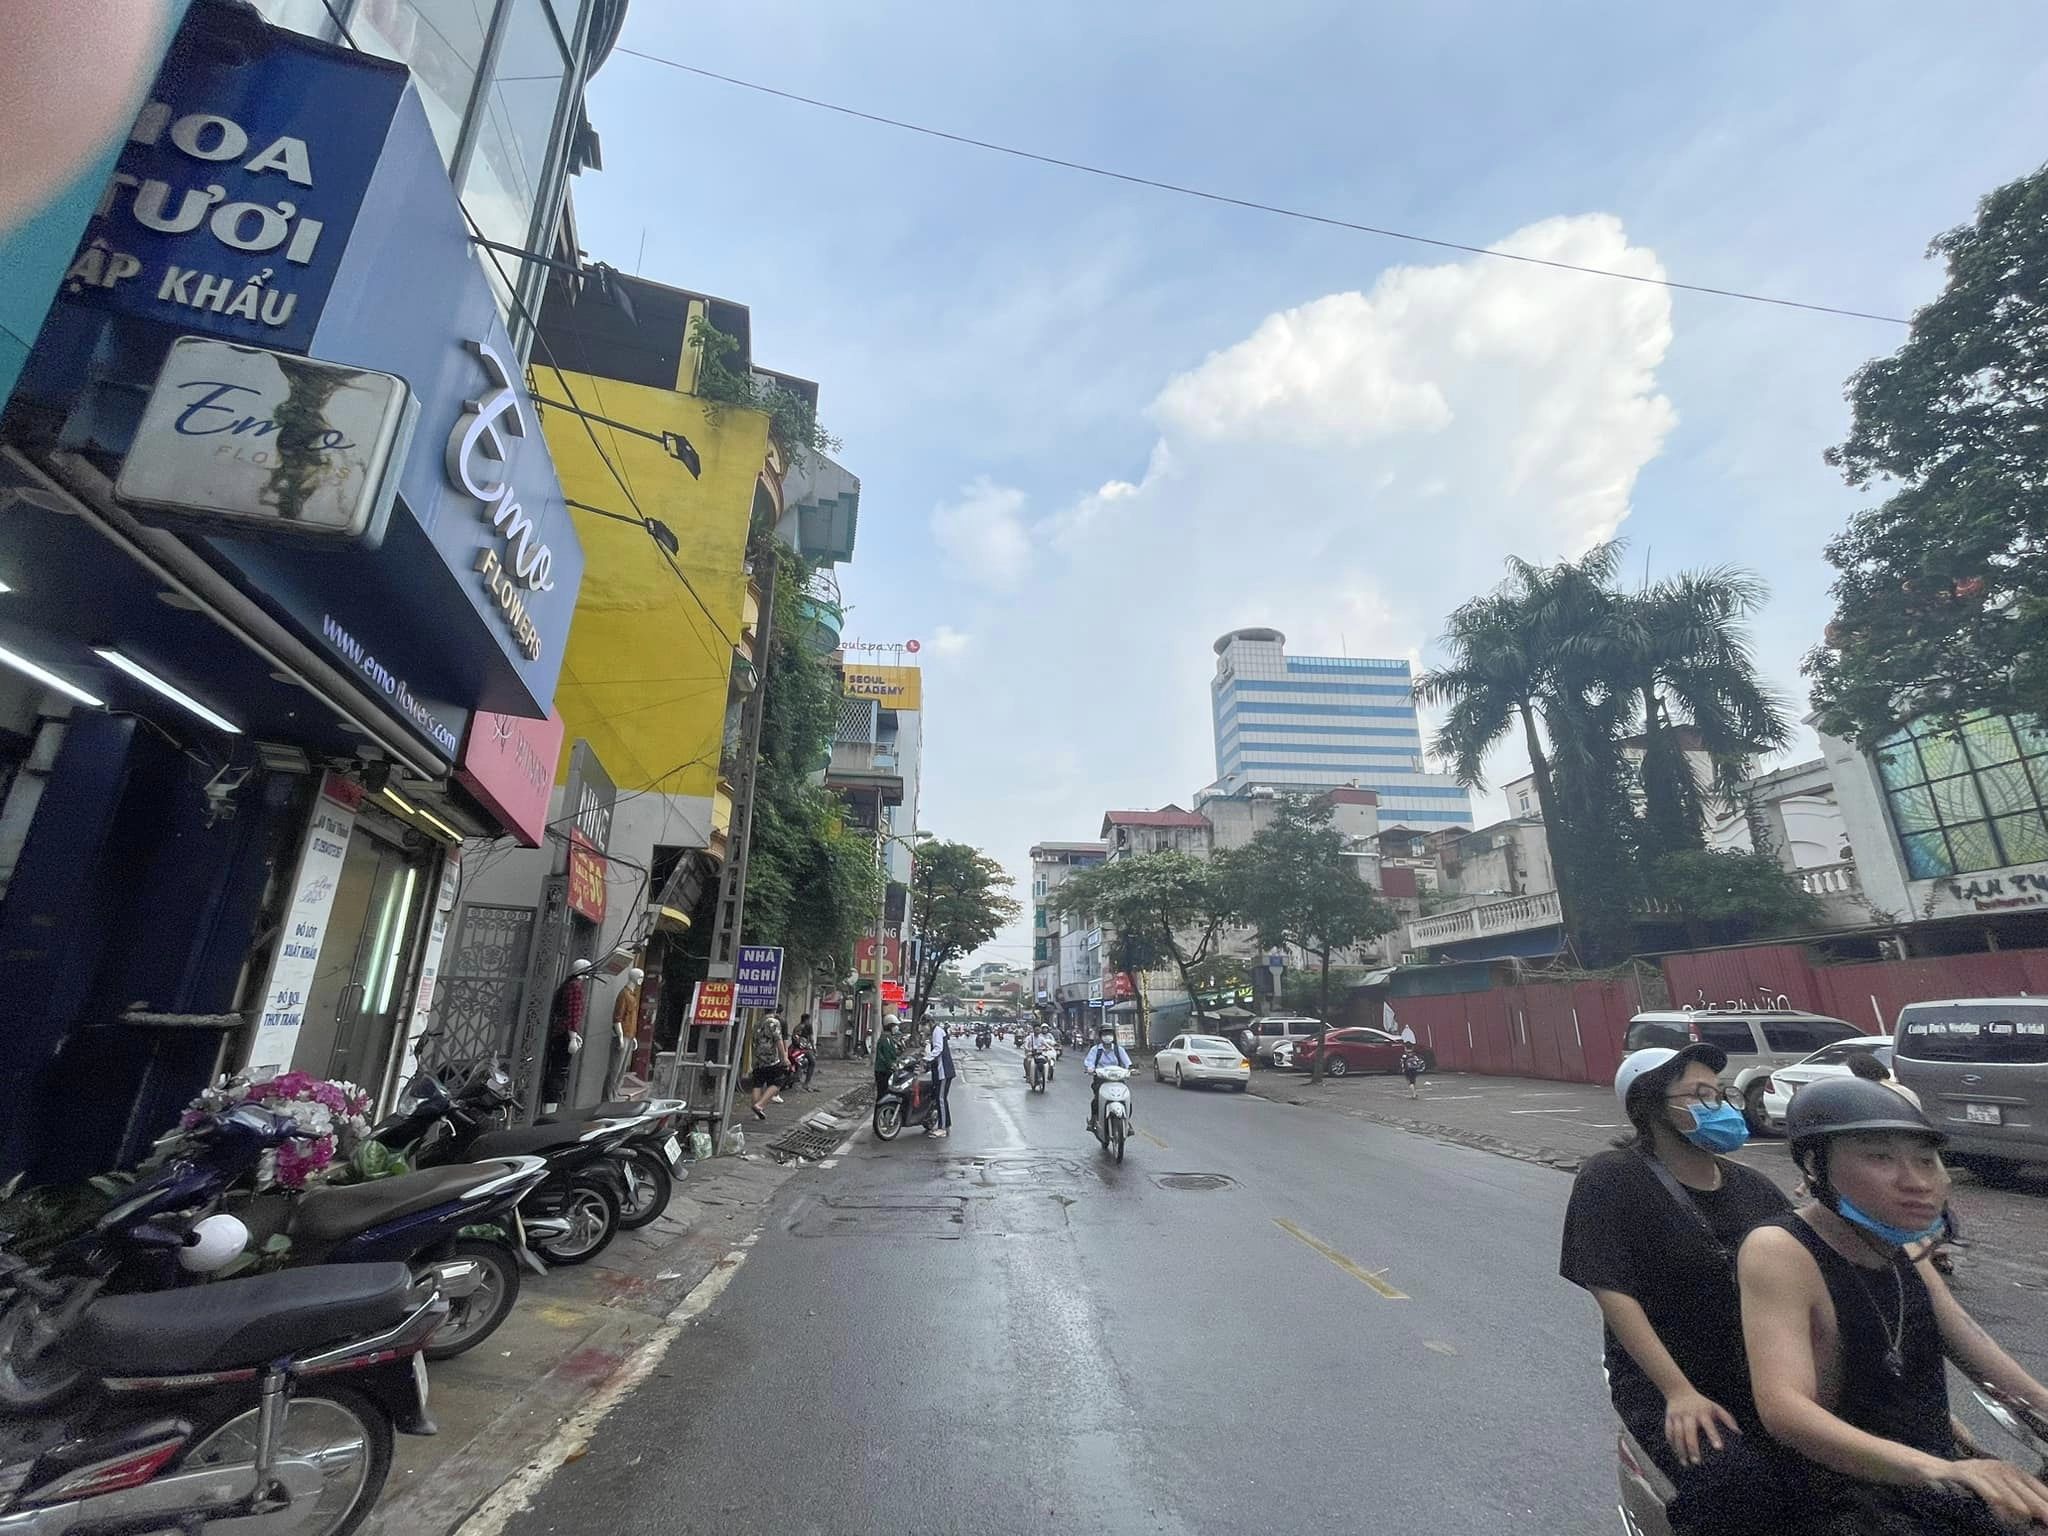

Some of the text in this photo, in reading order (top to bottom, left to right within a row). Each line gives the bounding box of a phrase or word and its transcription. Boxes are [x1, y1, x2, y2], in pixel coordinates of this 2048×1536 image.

[157, 266, 298, 326] KHẨU
[481, 548, 542, 661] FLOWERS
[849, 675, 885, 684] SEOUL
[850, 685, 904, 695] ACADEMY
[744, 949, 775, 962] NHÀ
[739, 966, 777, 981] NGHỈ
[706, 983, 728, 992] CHO
[700, 994, 730, 1006] THUÊ
[699, 1007, 728, 1019] GIÁO
